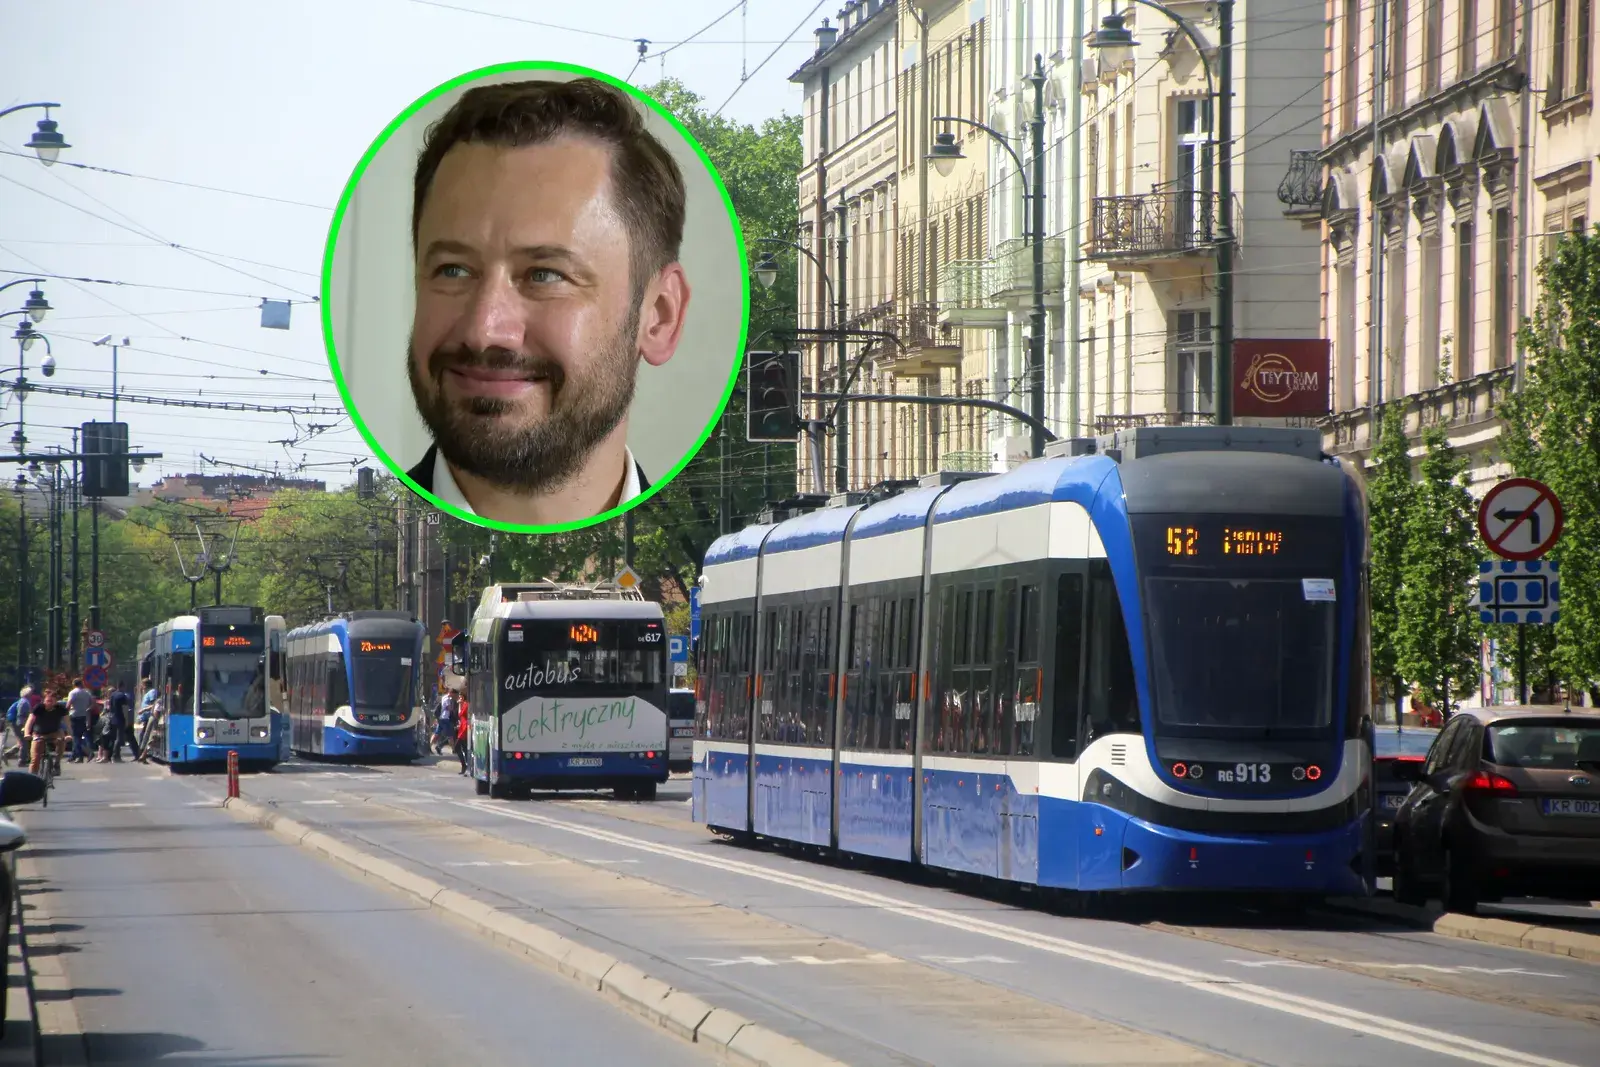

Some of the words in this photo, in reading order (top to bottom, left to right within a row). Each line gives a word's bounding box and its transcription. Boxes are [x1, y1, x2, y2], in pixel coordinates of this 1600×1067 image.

[1166, 527, 1199, 555] 52
[90, 634, 101, 643] 30
[361, 641, 371, 652] 73
[645, 633, 662, 642] 617
[669, 638, 682, 659] P
[504, 661, 581, 690] autobus
[507, 699, 636, 743] elektryczny
[1218, 770, 1233, 782] RG
[1236, 763, 1271, 782] 913
[1552, 800, 1570, 812] KR
